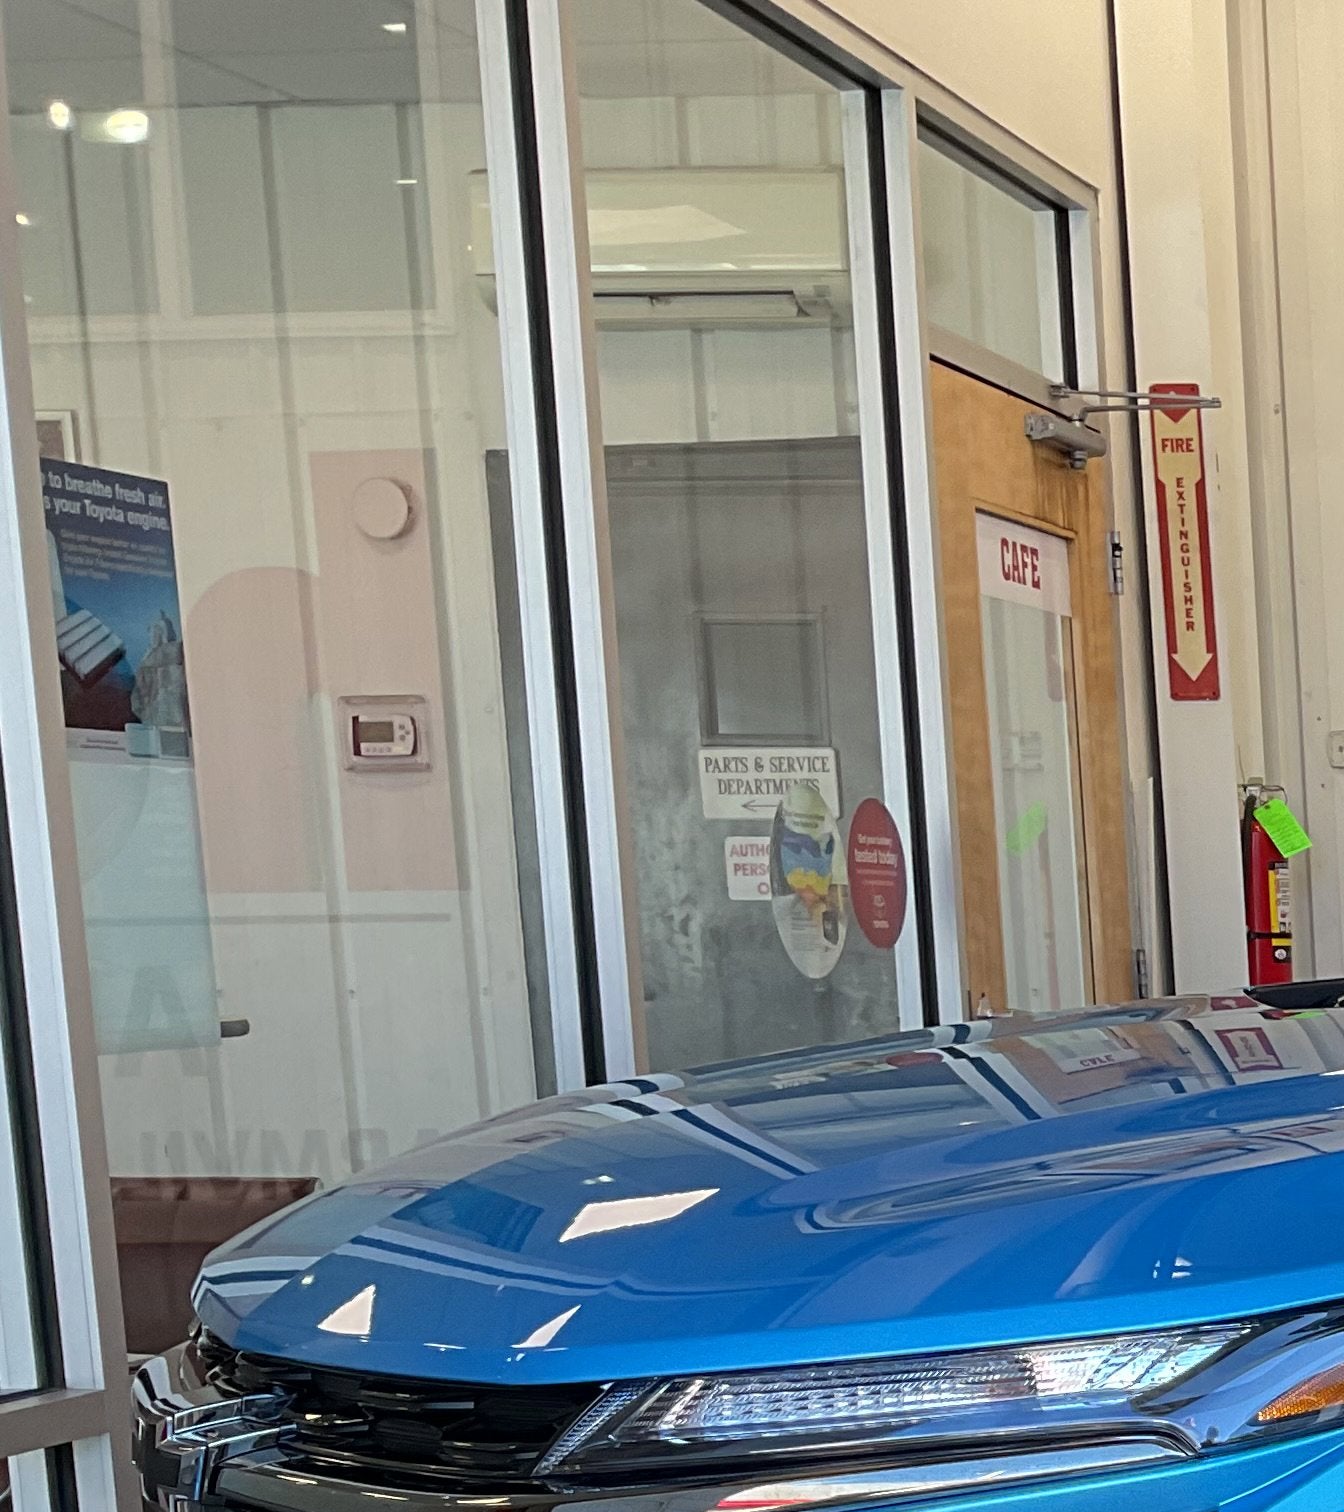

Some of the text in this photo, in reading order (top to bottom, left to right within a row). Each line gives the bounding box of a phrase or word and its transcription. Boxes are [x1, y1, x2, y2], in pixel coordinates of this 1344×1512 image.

[1161, 437, 1194, 453] FIRE
[48, 471, 62, 489] to
[64, 473, 112, 499] breathe
[115, 483, 145, 505] fresh
[53, 498, 81, 515] your
[84, 499, 125, 523] Toyota
[1001, 537, 1041, 590] CAFE
[1175, 476, 1195, 631] EXTINGUISHER
[704, 756, 831, 773] PARTS & SERVICE
[717, 778, 820, 795] DEPARTMES
